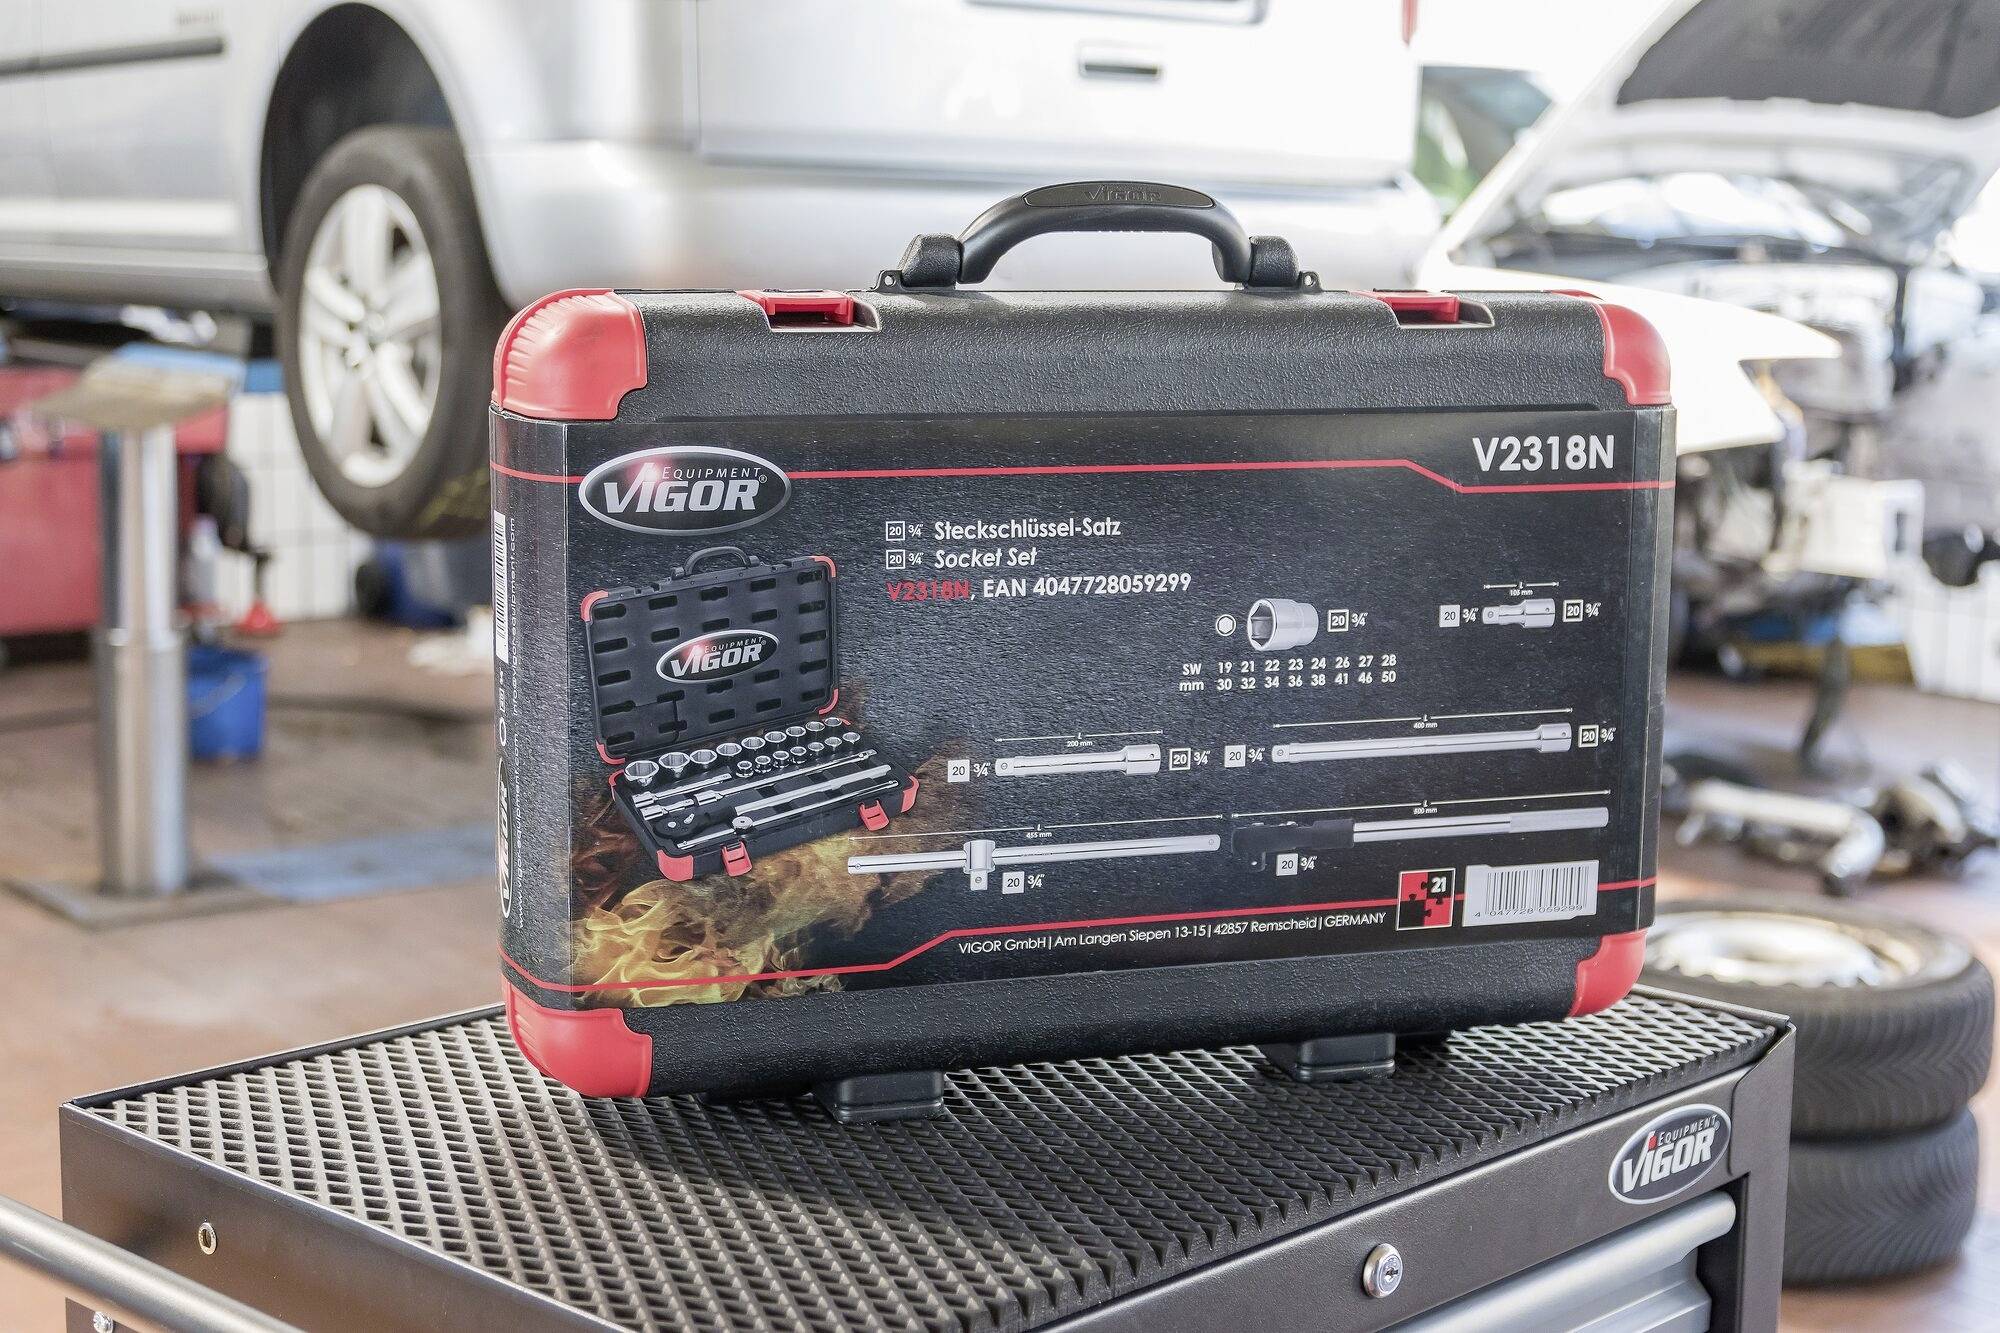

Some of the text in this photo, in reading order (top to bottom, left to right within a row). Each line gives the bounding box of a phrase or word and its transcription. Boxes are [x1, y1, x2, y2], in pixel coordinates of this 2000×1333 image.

[1472, 434, 1615, 472] V2318N
[662, 466, 761, 480] EQUIPMENT
[604, 463, 760, 513] VIGOR
[889, 525, 902, 536] 20
[934, 516, 1122, 541] Steckschlüssel-Satz
[889, 554, 902, 565] 20
[934, 549, 1002, 569] Socket
[1007, 547, 1038, 567] Set
[983, 578, 1027, 599] EAN
[1033, 572, 1192, 597] 4047728059299
[1444, 611, 1456, 621] 20
[1567, 605, 1580, 617] 20
[1331, 615, 1345, 626] 20
[670, 644, 762, 677] VIGOR
[1182, 654, 1397, 676] SW 19 21 22 23 24 26 27 28
[1179, 670, 1397, 692] mm 30 32 34 36 38 41 46 50
[1066, 740, 1079, 748] 200
[1583, 731, 1595, 742] 20
[1173, 753, 1187, 765] 20
[1229, 751, 1242, 761] 20
[952, 766, 966, 776] 20
[1281, 859, 1294, 869] 20
[1007, 878, 1020, 888] 20
[1430, 876, 1447, 894] 21
[959, 912, 1387, 954] VIGOR GmbH Am Langen Siepen 13-15 42857 Remscheid GERMANY
[1658, 1114, 1719, 1147] EQUIPMENT
[1622, 1127, 1717, 1193] VIGOR
